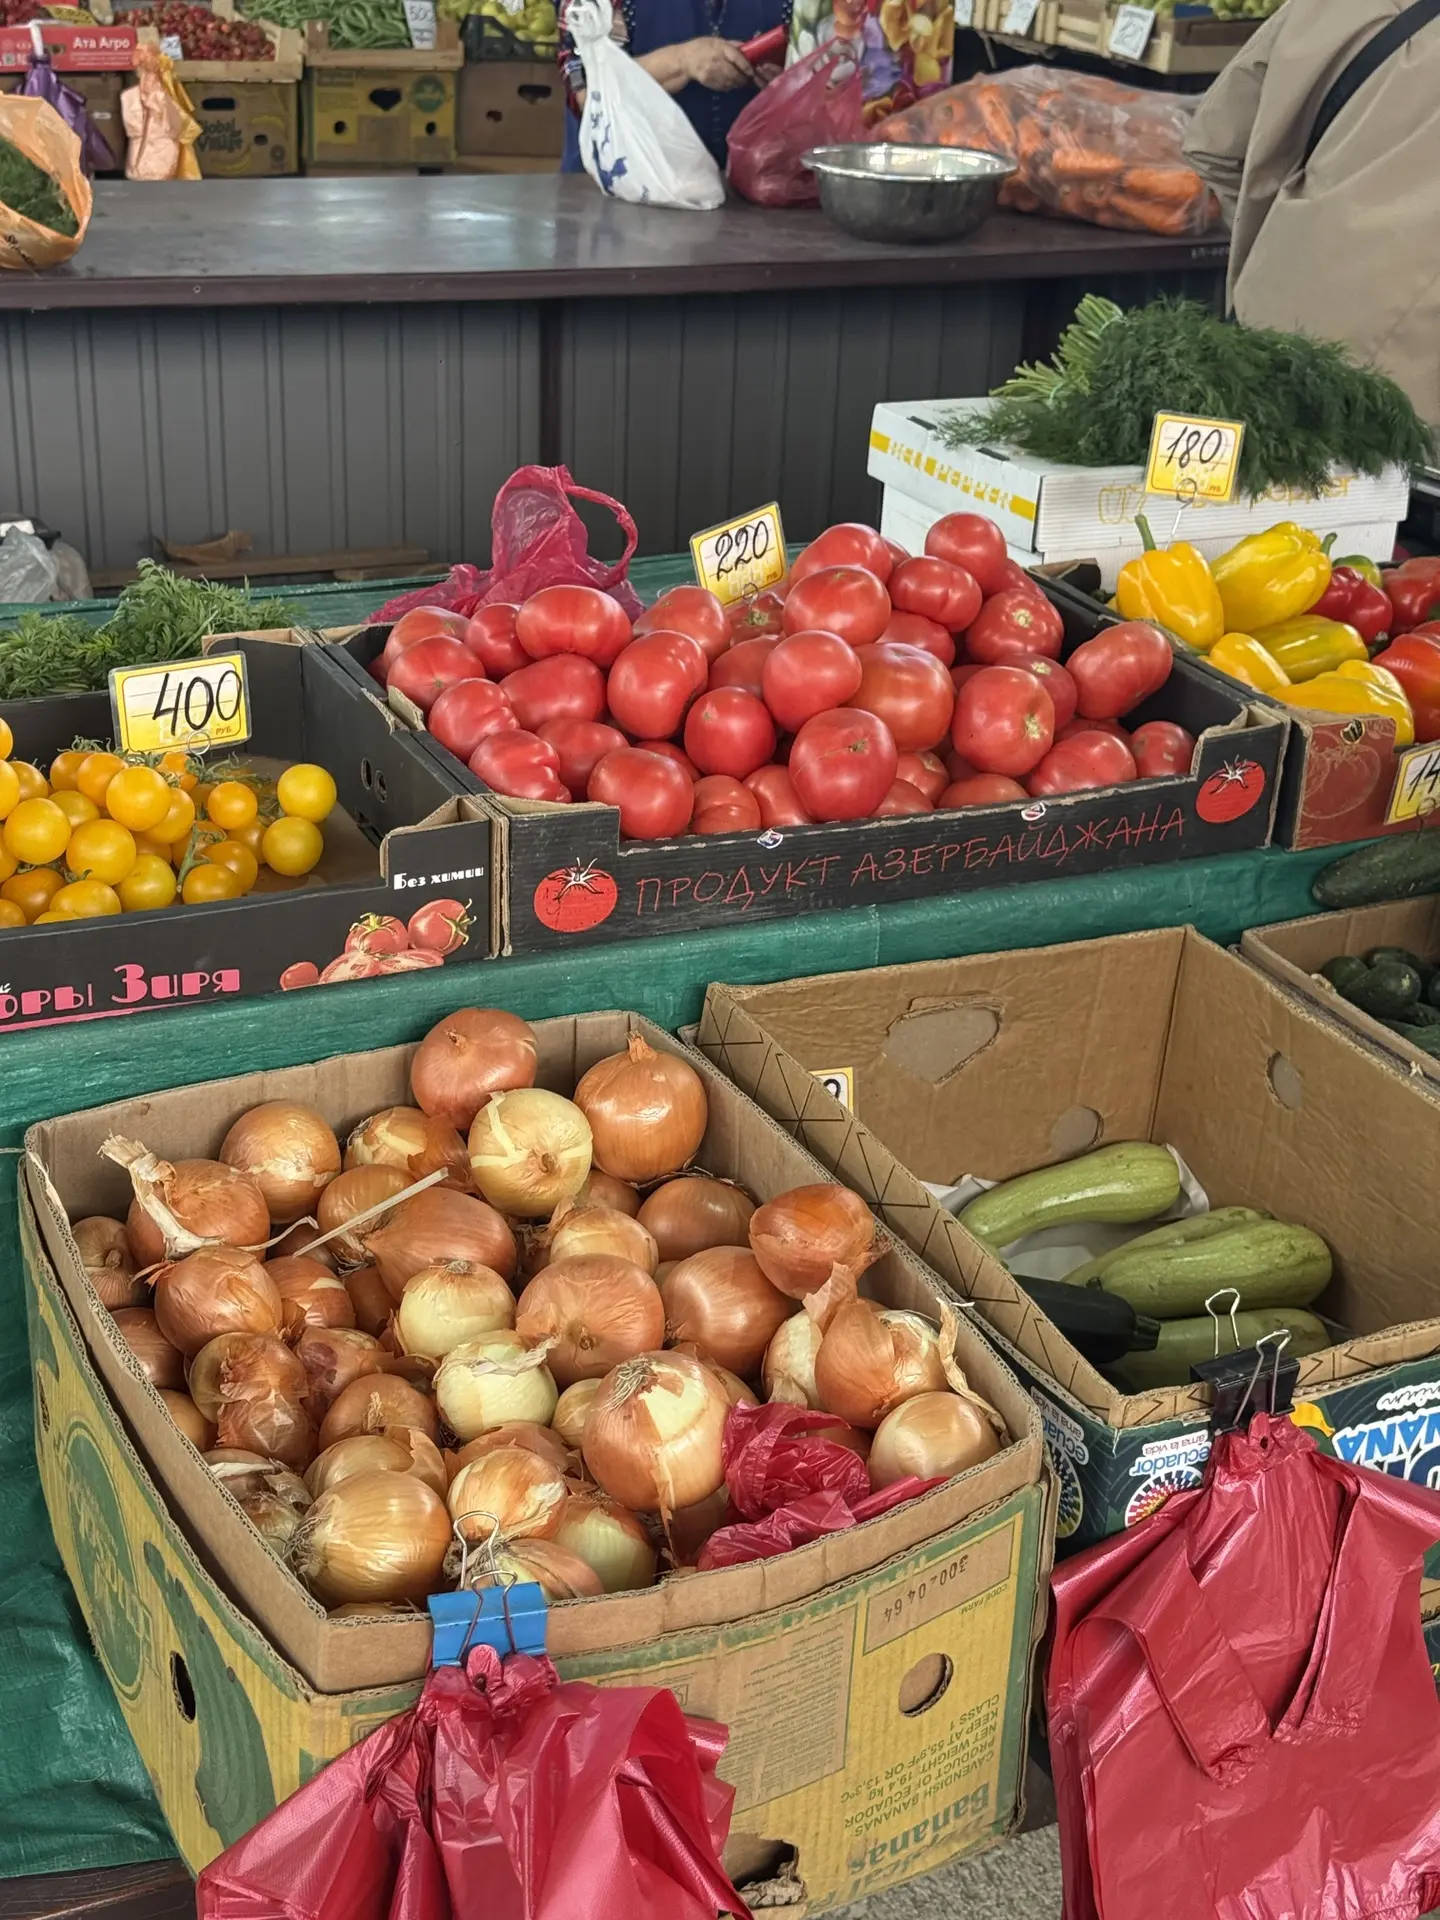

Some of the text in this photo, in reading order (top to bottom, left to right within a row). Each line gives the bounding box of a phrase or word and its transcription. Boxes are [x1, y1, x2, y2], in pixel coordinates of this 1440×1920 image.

[73, 36, 131, 51] Ата Агро
[1165, 425, 1222, 468] 180
[715, 520, 769, 582] 220
[152, 670, 242, 736] 400
[636, 804, 1186, 915] ПРОДУКТ АЗЕРБАЙДЖАНА
[394, 867, 484, 890] Без химии
[1132, 1446, 1210, 1474] ecuador
[950, 1693, 1000, 1731] CLASS 1
[966, 1707, 999, 1734] KEEP
[947, 1727, 963, 1744] AT
[973, 1721, 997, 1745] NET
[844, 1736, 995, 1829] PRODUCT OF ECUADOR
[884, 1762, 905, 1780] OR
[924, 1750, 994, 1797] CAVENDISH
[868, 1785, 884, 1801] kg
[848, 1782, 989, 1876] Bananas
